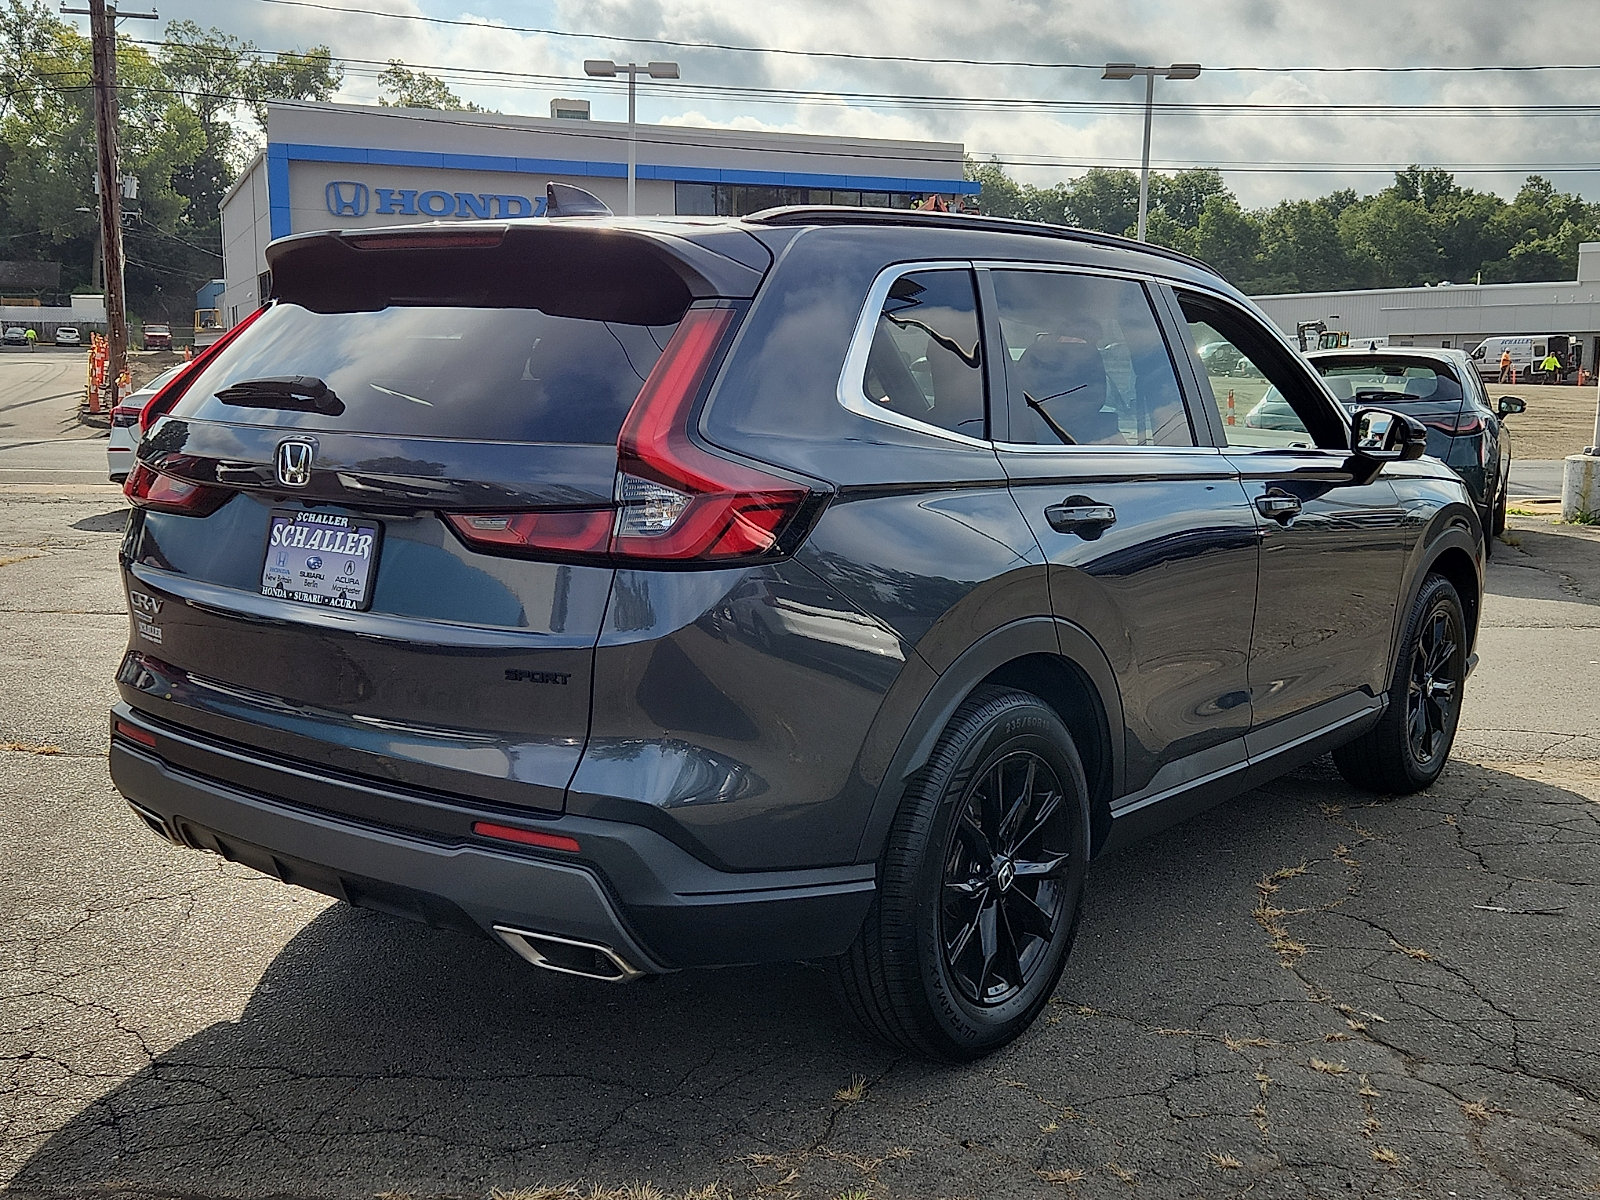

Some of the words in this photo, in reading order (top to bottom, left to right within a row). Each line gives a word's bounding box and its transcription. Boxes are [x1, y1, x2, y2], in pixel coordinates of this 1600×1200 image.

[296, 512, 349, 528] SCHALLER
[270, 523, 373, 560] SCHALLER
[265, 573, 276, 582] New
[299, 570, 325, 581] SUBARU
[303, 578, 319, 589] Berlin
[334, 576, 360, 586] ACURA
[130, 589, 164, 614] CR-V
[262, 587, 287, 598] HONDA
[294, 592, 323, 603] SUBARU
[330, 598, 357, 609] ACURA
[504, 668, 572, 685] SPORT
